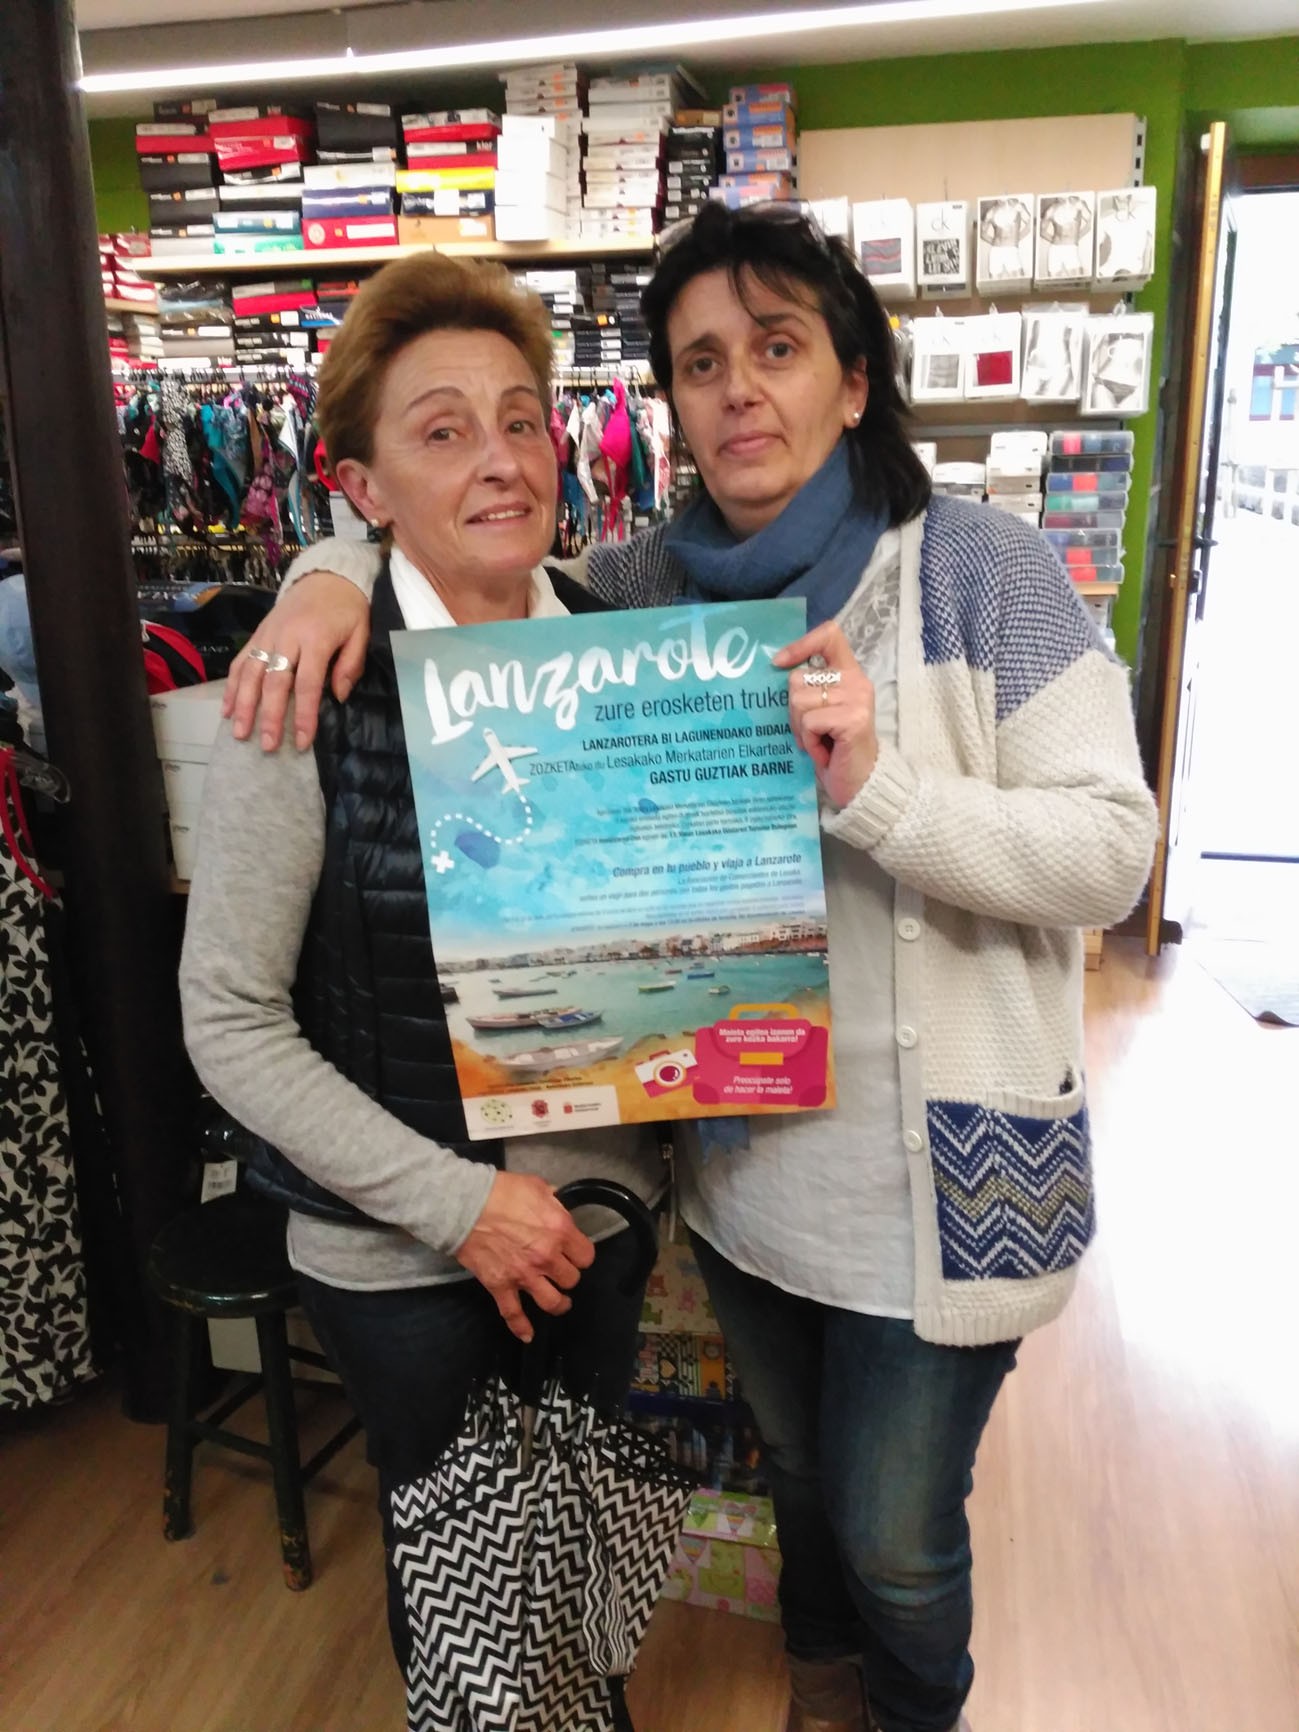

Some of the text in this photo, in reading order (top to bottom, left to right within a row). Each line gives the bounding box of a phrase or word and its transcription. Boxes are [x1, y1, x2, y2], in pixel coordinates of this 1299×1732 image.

[423, 604, 759, 745] Lanzarote
[595, 686, 789, 722] zure erosketen truke
[582, 723, 792, 751] LANZAROTERA BI LAGUNENDAKO BIDAIA
[606, 754, 661, 770] Lesakako
[665, 747, 735, 764] Merkatarien
[738, 741, 793, 758] Elkarteak
[650, 760, 795, 785] GASTU GUZTIAK BARNE
[612, 866, 650, 878] Compra
[652, 865, 664, 874] en
[679, 860, 711, 875] pueblo
[713, 861, 718, 871] y
[746, 858, 753, 867] a
[755, 854, 801, 866] Lanzarote
[735, 1085, 757, 1094] hacer
